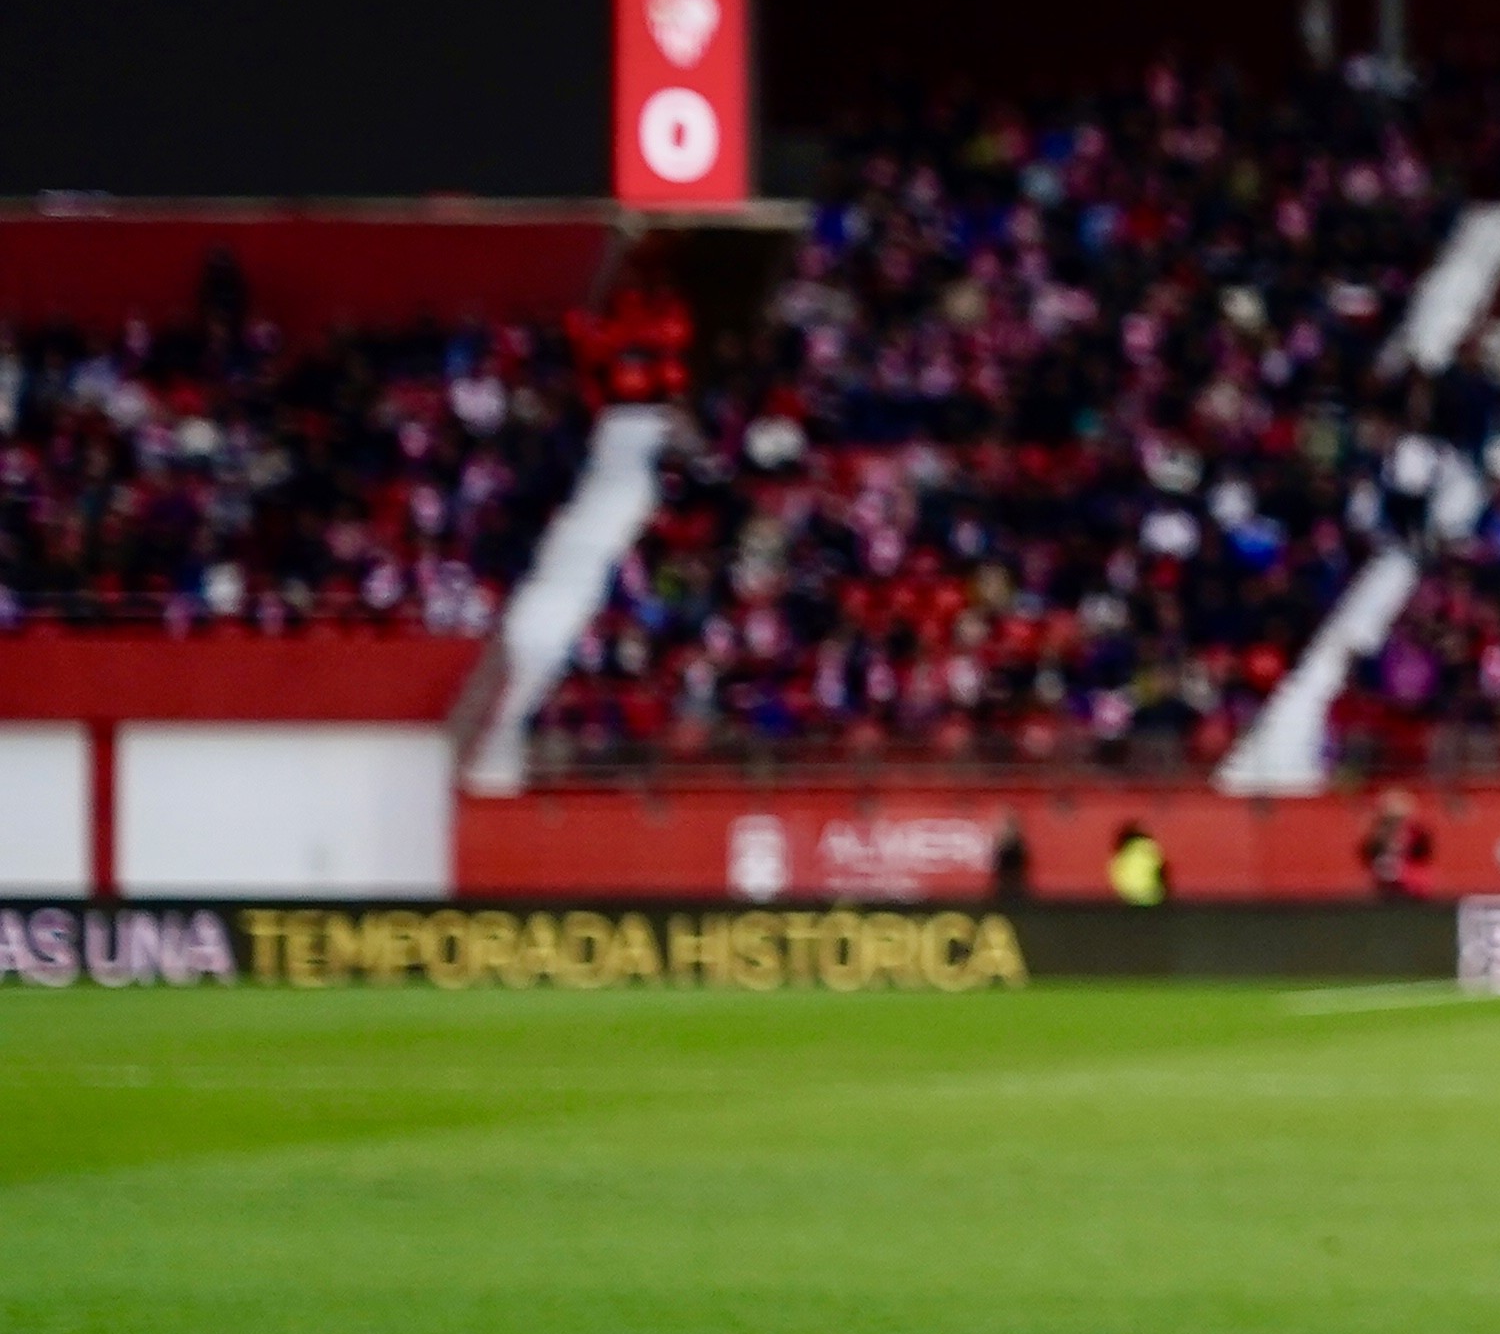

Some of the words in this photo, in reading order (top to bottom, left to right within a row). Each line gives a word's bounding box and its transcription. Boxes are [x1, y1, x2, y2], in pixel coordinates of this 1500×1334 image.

[638, 87, 721, 184] 0
[84, 909, 237, 988] UNA
[241, 909, 661, 989] TEMPORADA
